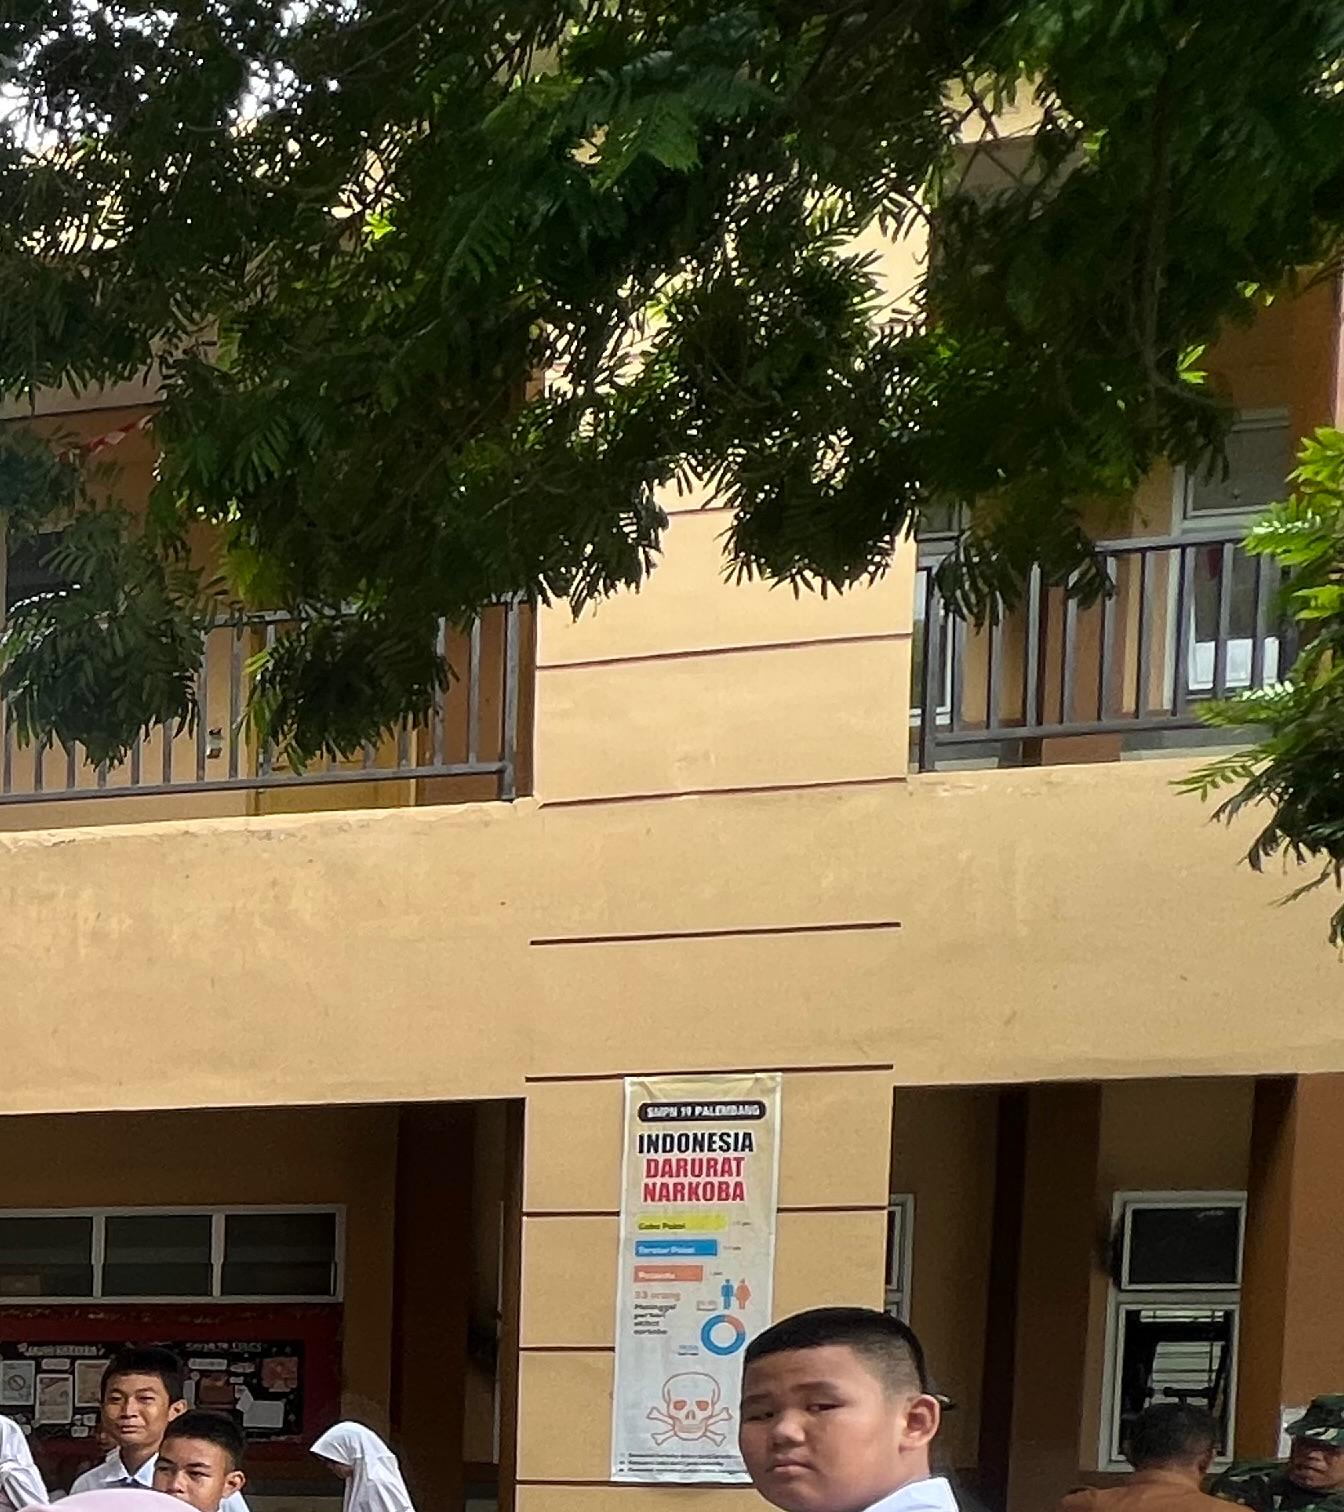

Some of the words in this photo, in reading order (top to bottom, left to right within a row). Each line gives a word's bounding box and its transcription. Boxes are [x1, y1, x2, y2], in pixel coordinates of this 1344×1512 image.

[638, 1131, 754, 1154] INDONESIA
[645, 1156, 746, 1179] DARURAT
[643, 1180, 746, 1203] NARKOBA
